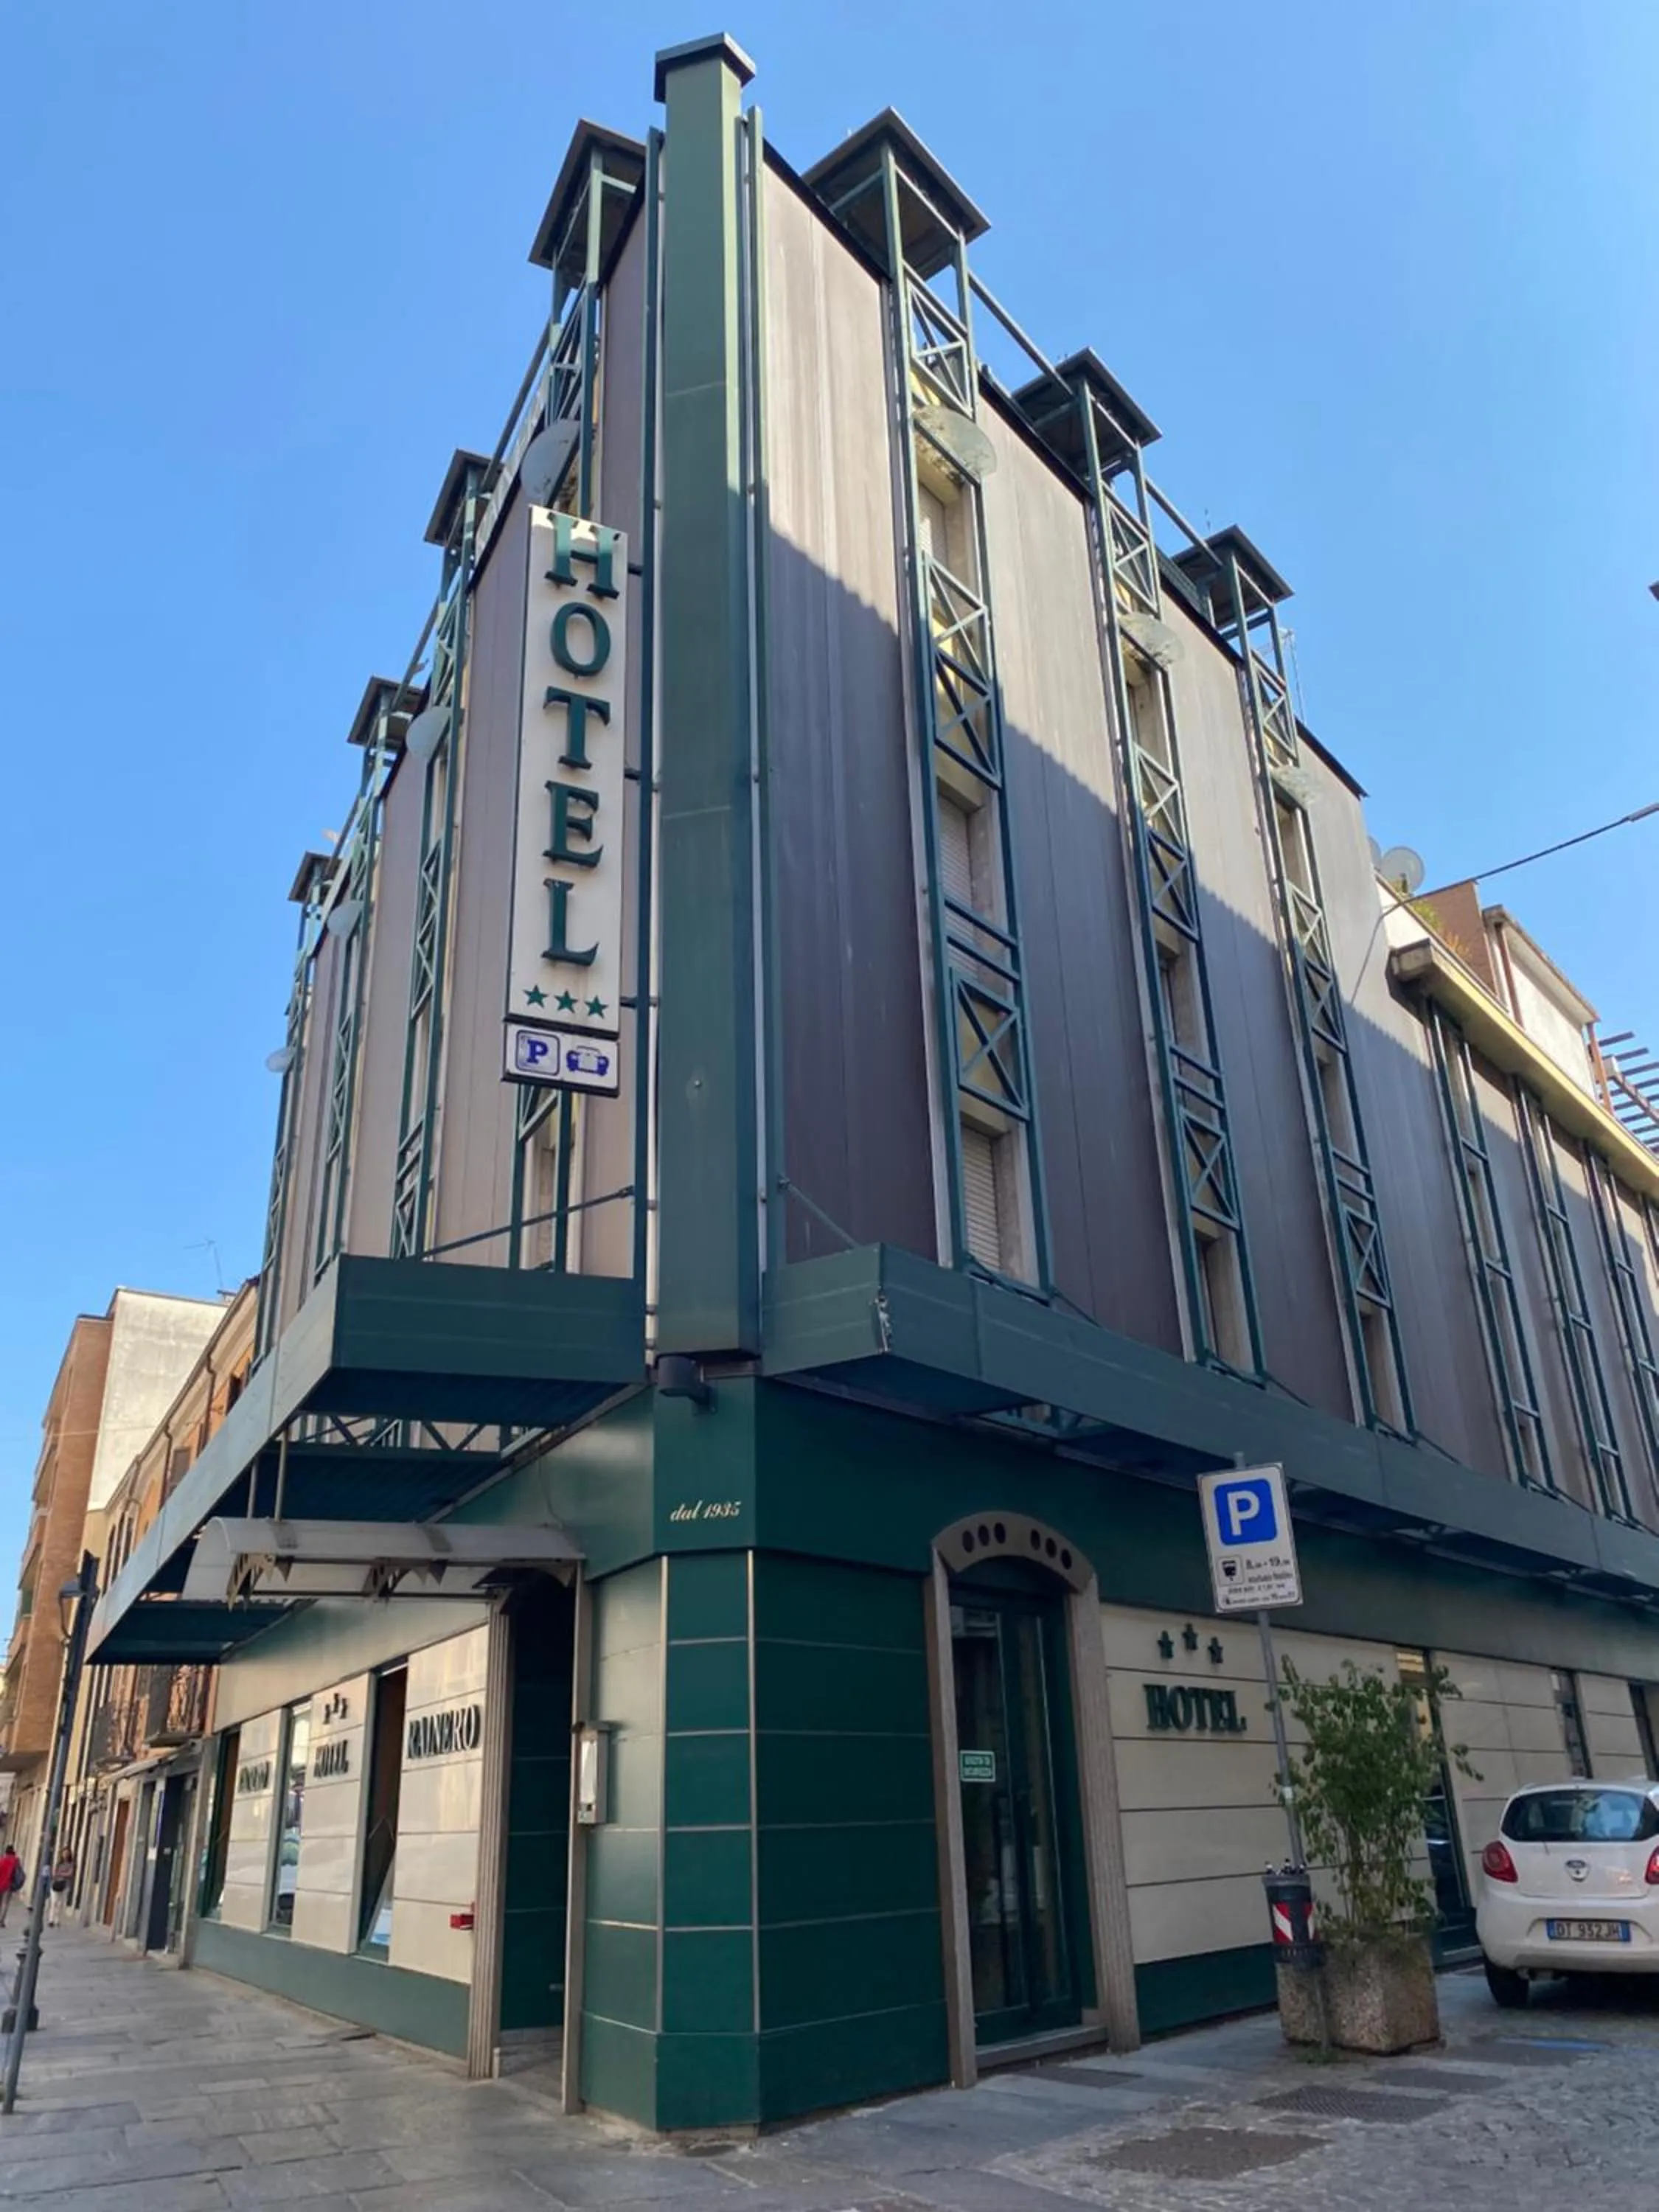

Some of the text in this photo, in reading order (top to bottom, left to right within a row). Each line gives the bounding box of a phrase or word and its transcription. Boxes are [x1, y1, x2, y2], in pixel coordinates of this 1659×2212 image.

[543, 512, 622, 968] HOTEL
[526, 1038, 549, 1065] P
[669, 1500, 742, 1522] dal 1935
[1227, 1489, 1260, 1537] P
[1143, 1684, 1247, 1732] HOTEL
